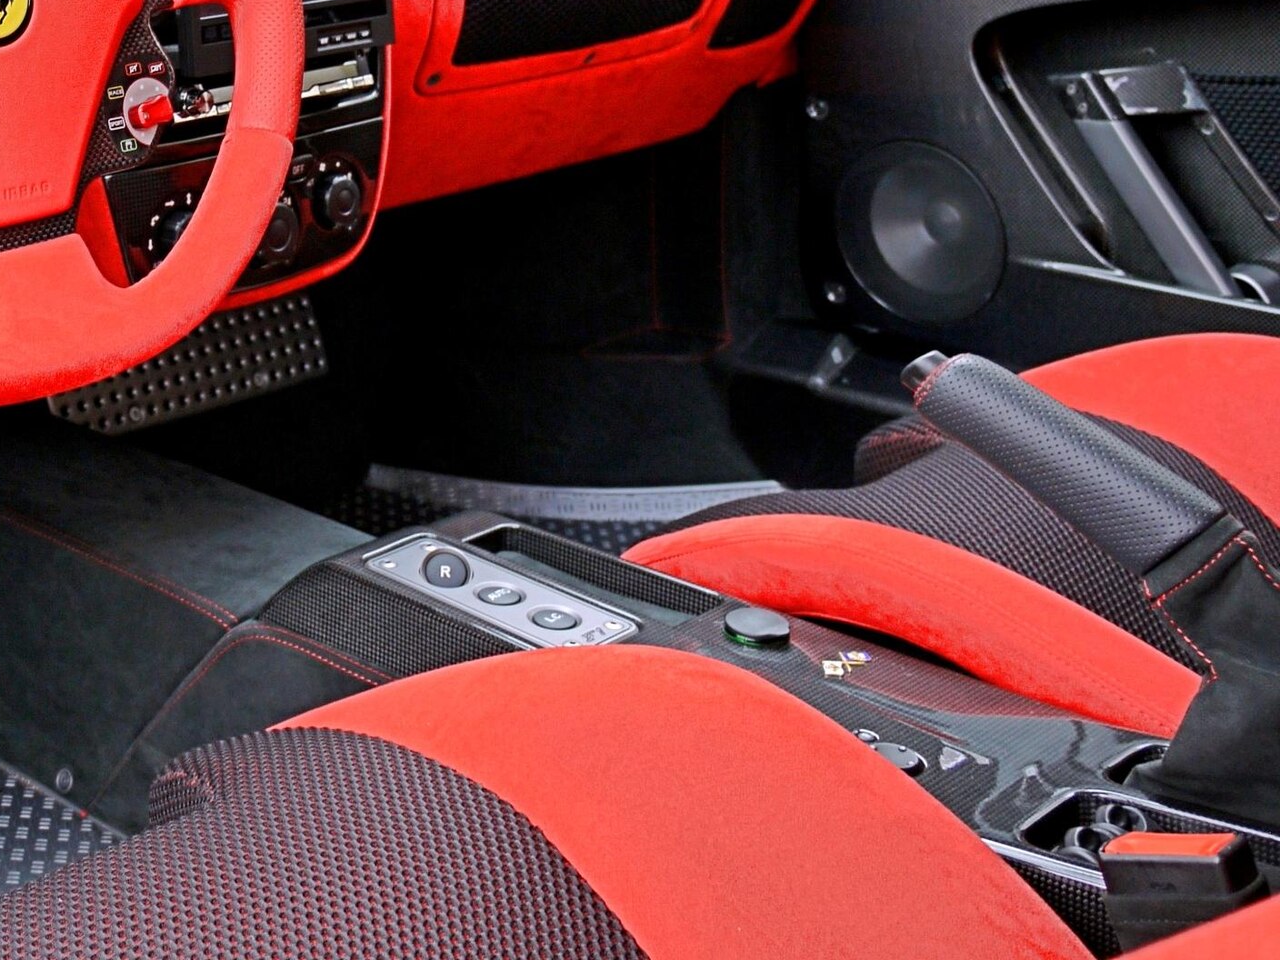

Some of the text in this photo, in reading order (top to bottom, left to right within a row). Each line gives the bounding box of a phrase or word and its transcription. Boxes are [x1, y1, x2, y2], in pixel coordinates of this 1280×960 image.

[440, 565, 450, 578] R
[488, 588, 511, 601] AUTO
[545, 613, 561, 622] LC
